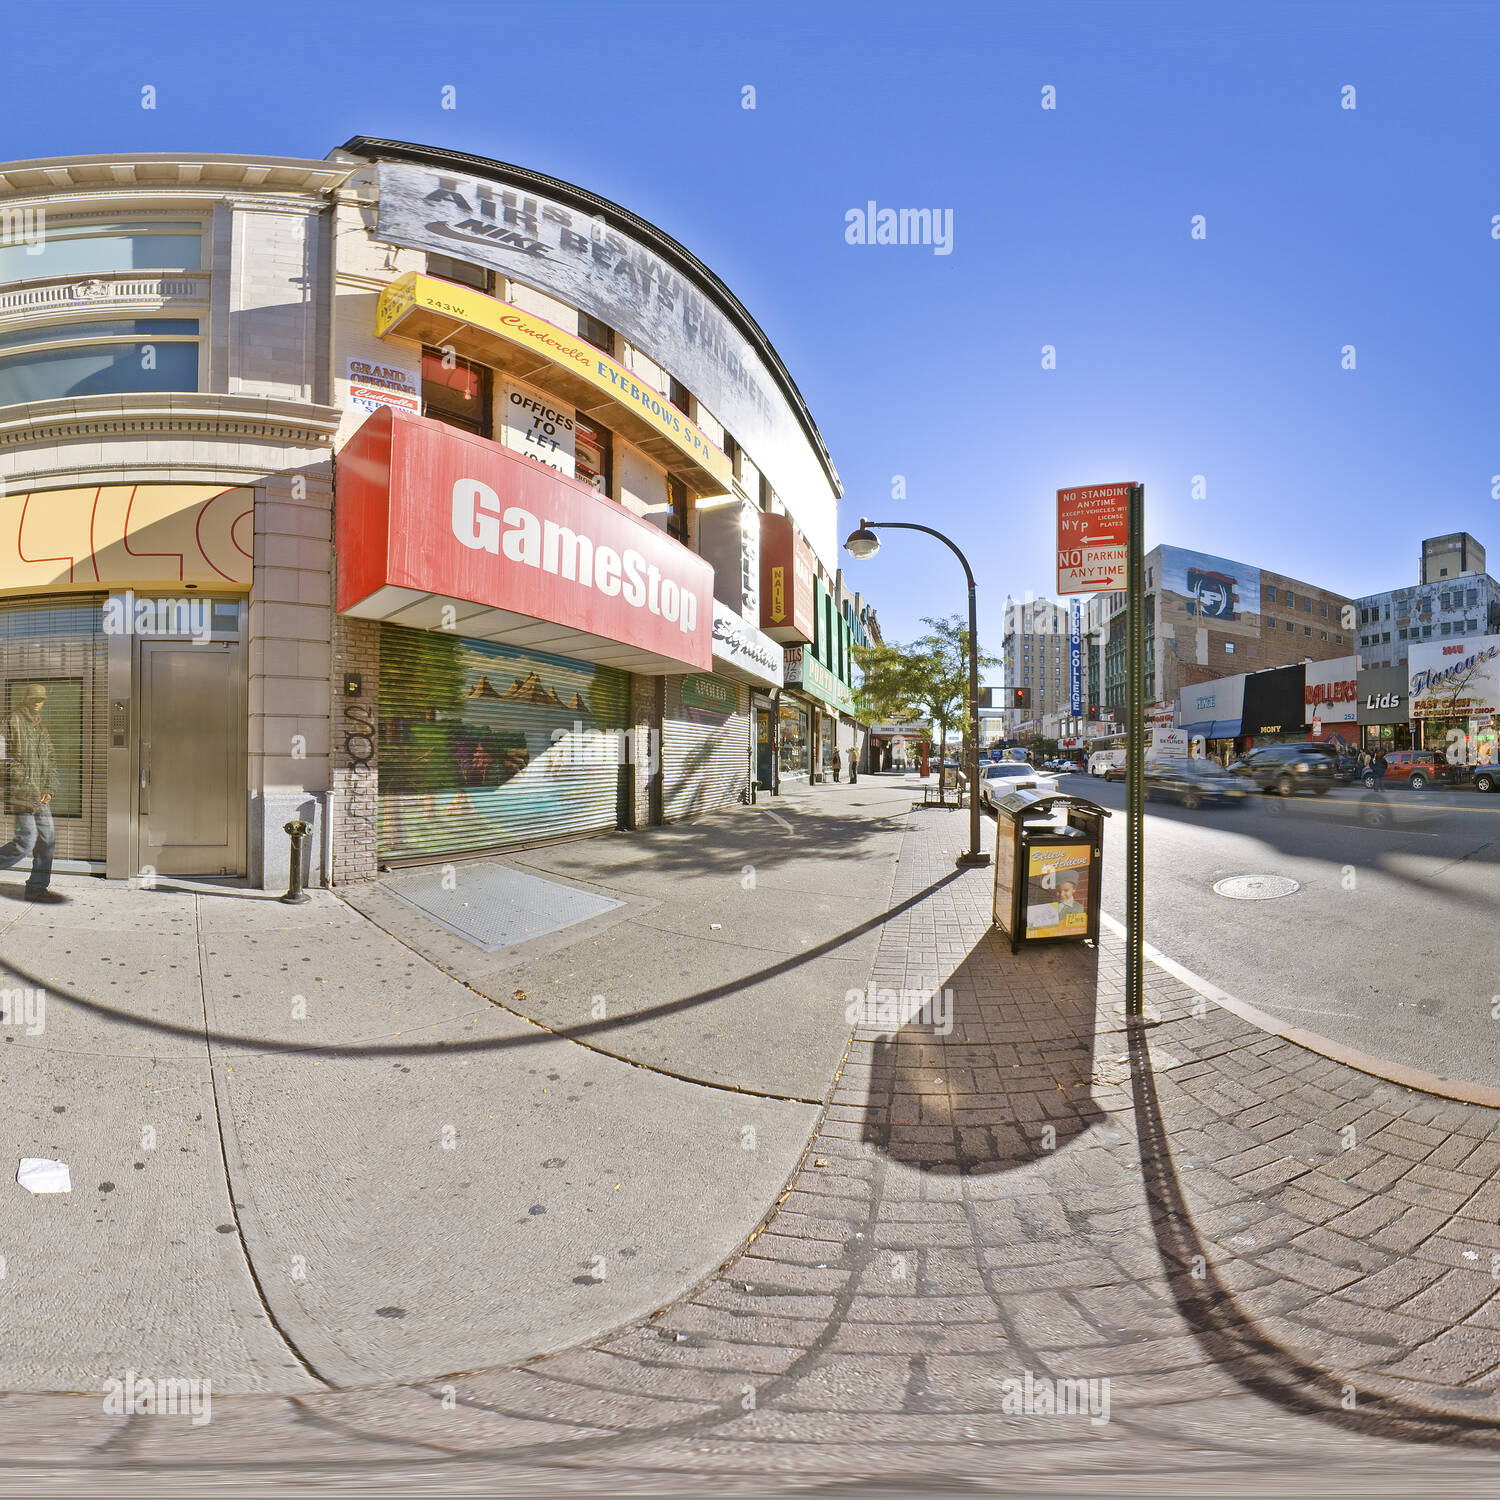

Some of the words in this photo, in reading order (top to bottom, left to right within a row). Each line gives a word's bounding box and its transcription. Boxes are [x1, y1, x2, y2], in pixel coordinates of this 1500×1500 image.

[425, 172, 574, 228] THIS
[424, 188, 539, 241] AIR
[560, 226, 675, 312] BEATS
[453, 218, 556, 260] NIKE
[350, 361, 406, 383] GRAND
[350, 373, 417, 398] OPENING
[499, 314, 592, 368] Cinderella
[597, 360, 680, 433] EYEBROWS
[683, 426, 711, 460] SPA
[354, 389, 414, 407] Cinderella
[509, 391, 574, 431] OFFICES
[533, 415, 556, 437] TO
[525, 428, 561, 453] LET
[1063, 491, 1077, 502] NO
[1077, 498, 1116, 509] ANYTIME
[1085, 507, 1115, 515] VEHICLES
[1097, 513, 1124, 521] LICENSE
[1061, 520, 1089, 533] NYP
[451, 477, 698, 633] GameStop
[1059, 551, 1081, 568] NO
[1069, 565, 1125, 578] ANYTIME
[774, 570, 783, 614] NAILS
[1071, 600, 1080, 645] TOURO
[783, 648, 802, 662] AILS
[1071, 649, 1080, 711] COLLEGE
[1366, 692, 1400, 710] Lids
[1344, 713, 1355, 721] 252
